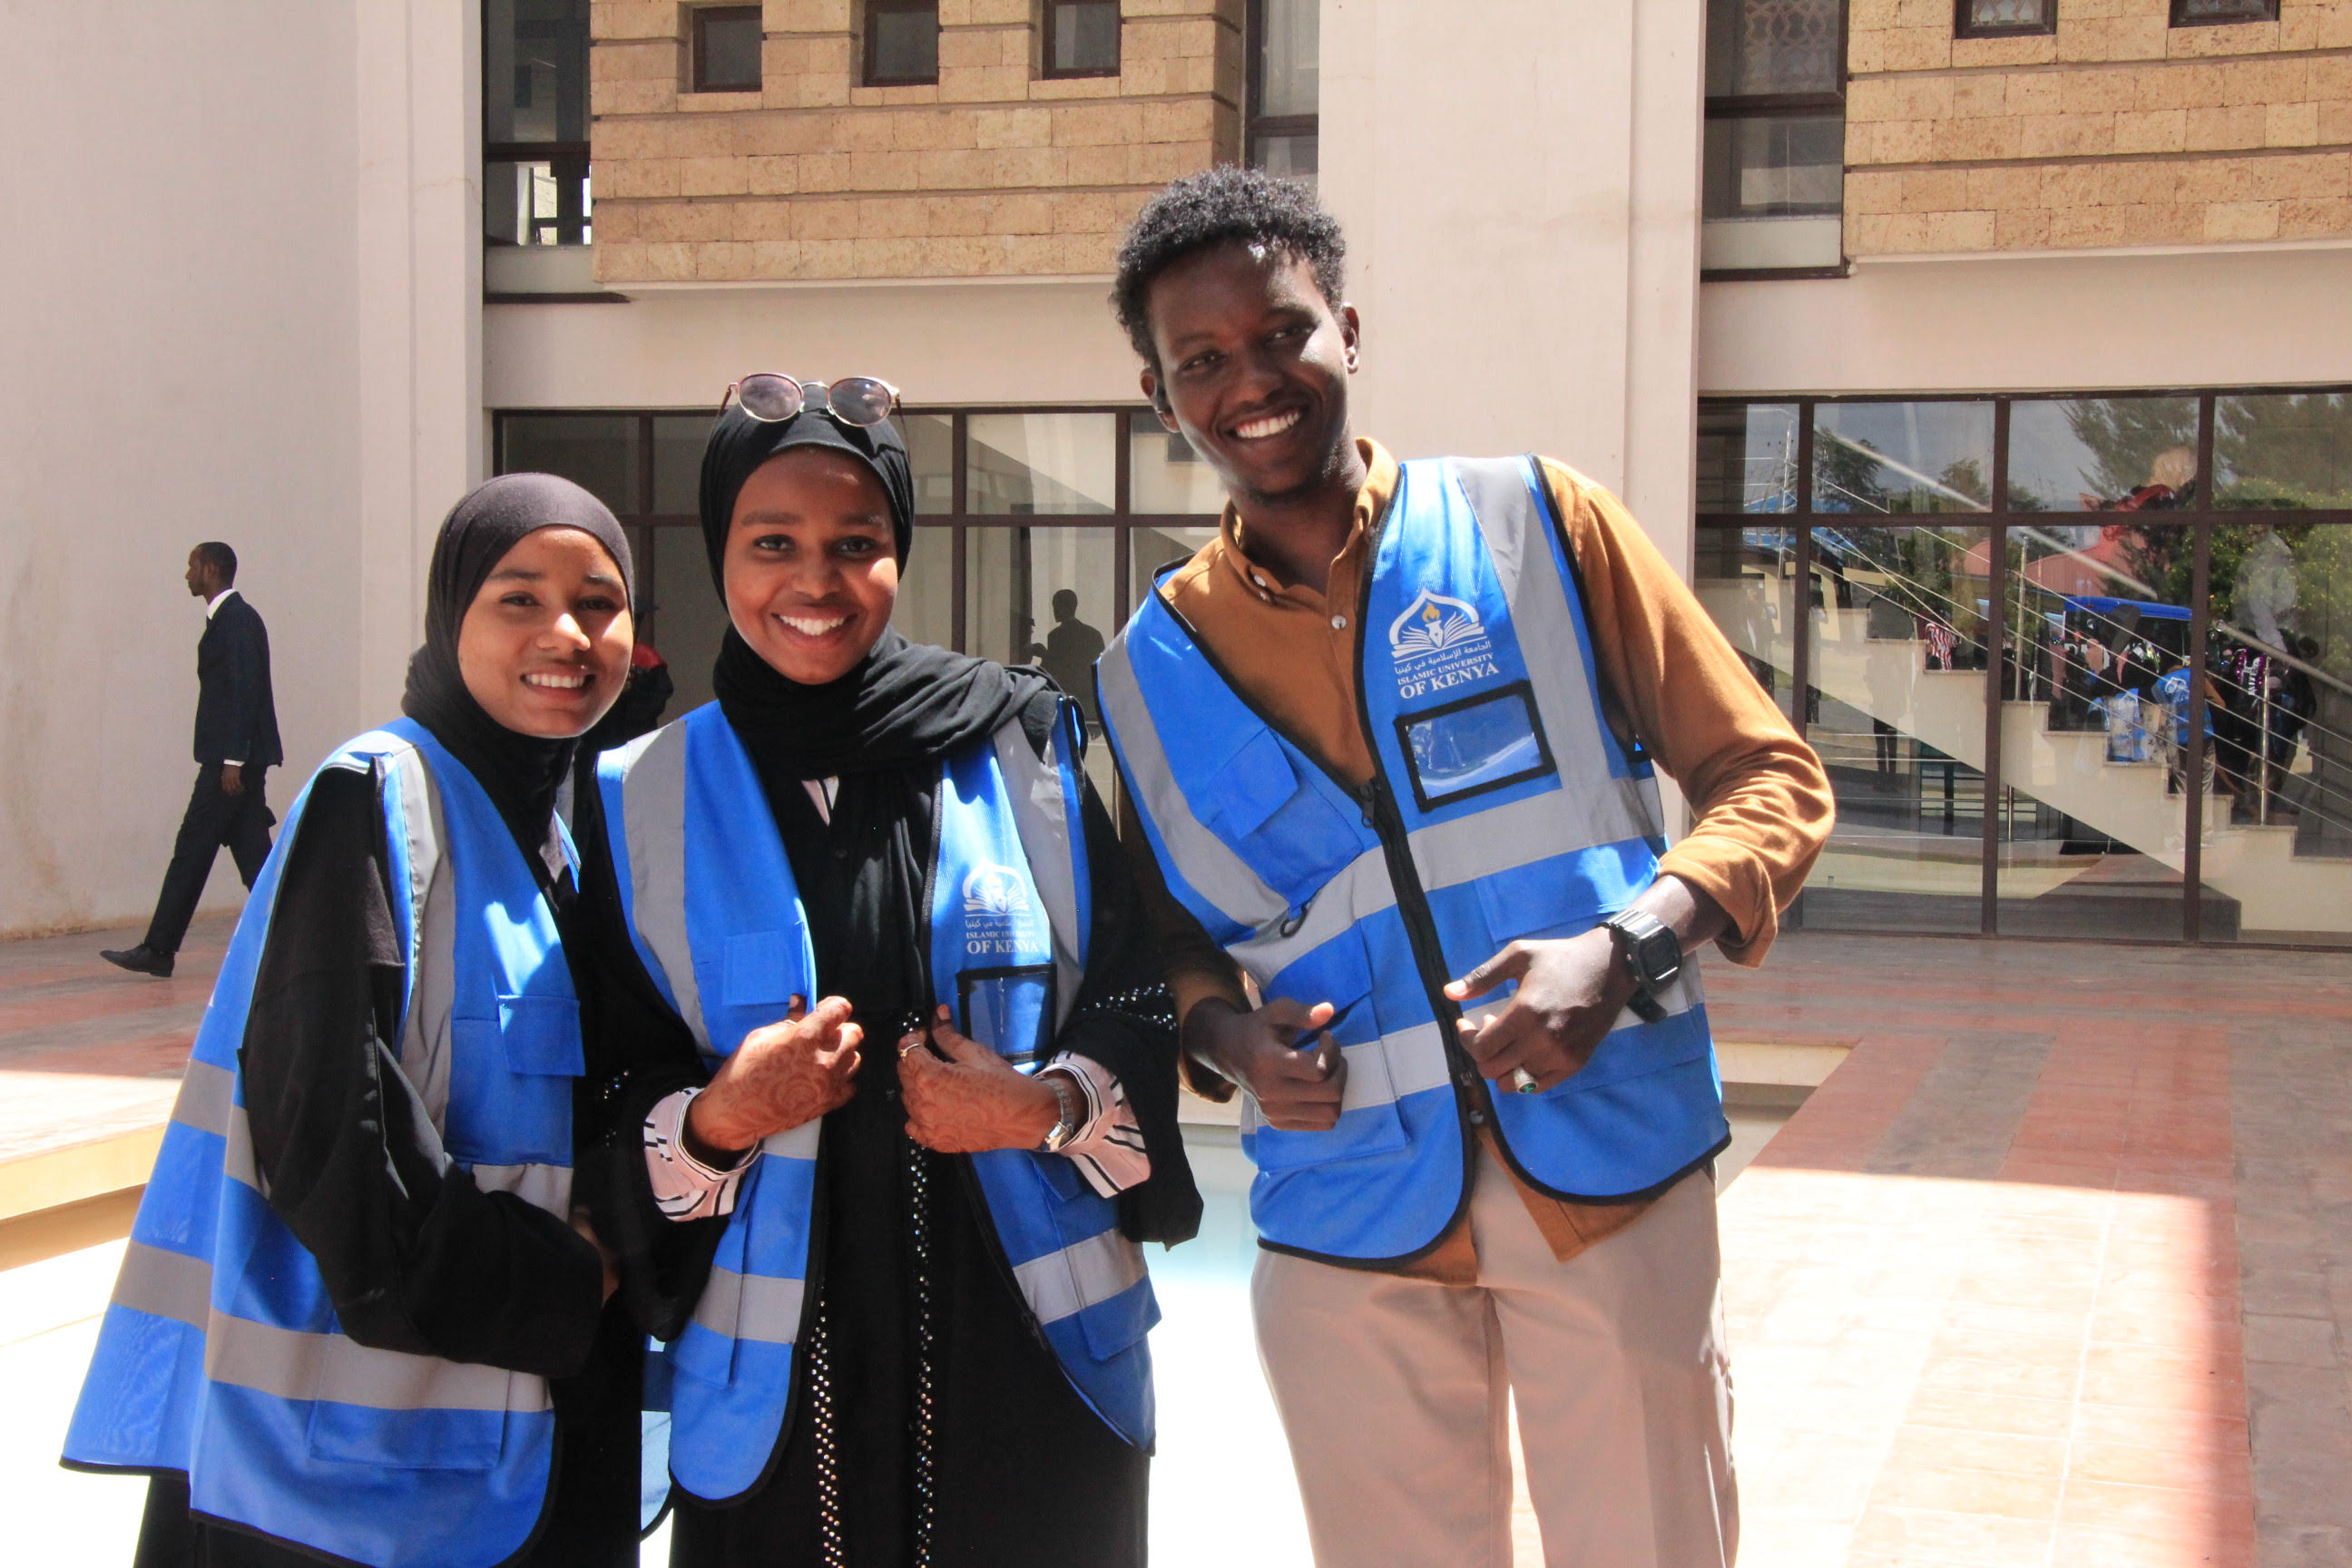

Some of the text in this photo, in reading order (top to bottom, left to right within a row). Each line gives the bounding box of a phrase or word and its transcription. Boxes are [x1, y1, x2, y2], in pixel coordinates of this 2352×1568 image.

[1464, 640, 1492, 654] الجامعة
[1394, 662, 1412, 675] كينيا
[1397, 652, 1494, 686] ISLAMIC UNIVERSITY
[1414, 660, 1426, 671] في
[1400, 662, 1500, 699] OF KENYA
[966, 931, 1000, 939] ISLAMIC
[966, 938, 1039, 955] OF KENYA
